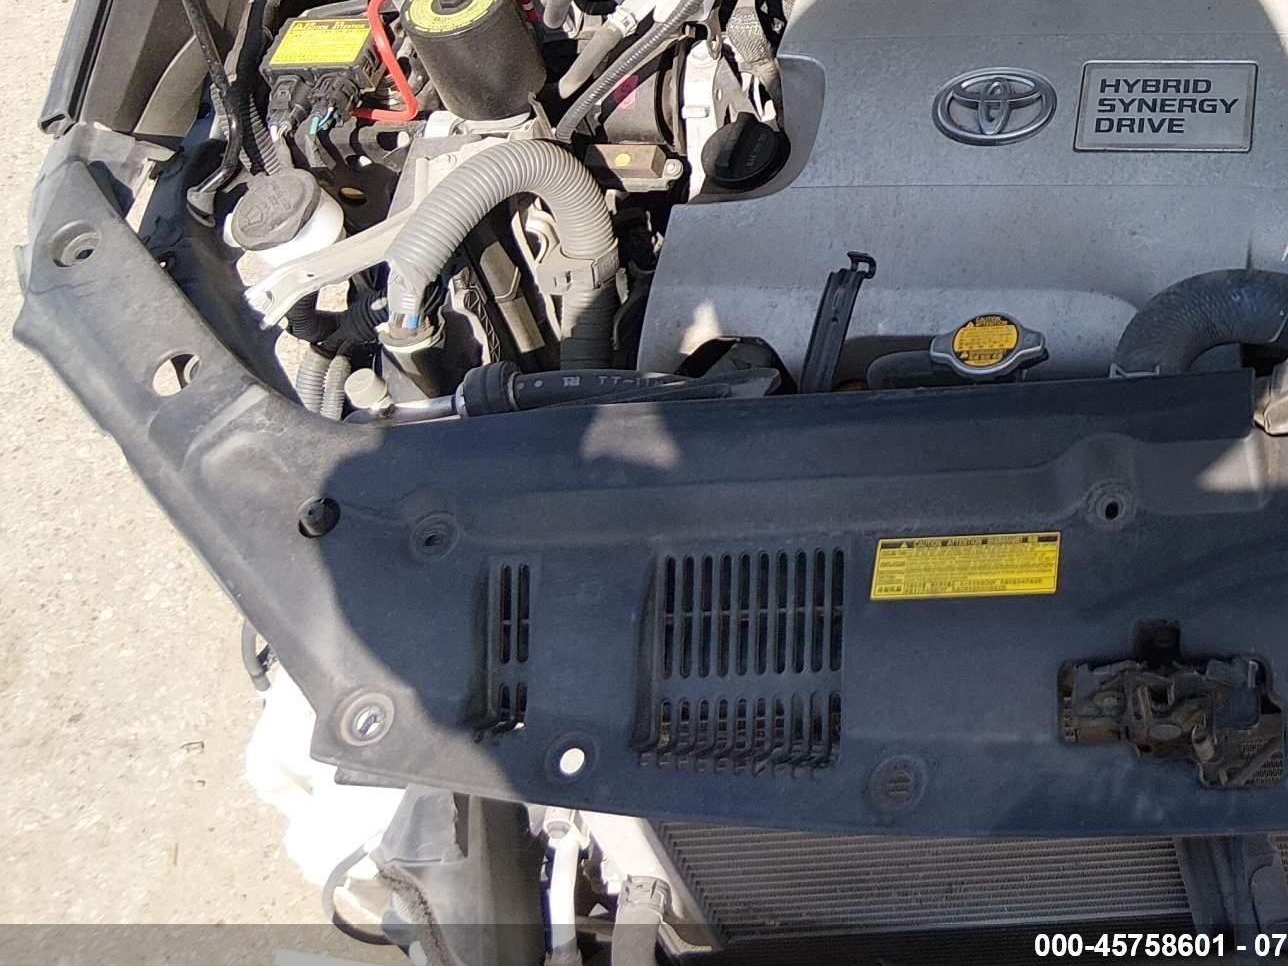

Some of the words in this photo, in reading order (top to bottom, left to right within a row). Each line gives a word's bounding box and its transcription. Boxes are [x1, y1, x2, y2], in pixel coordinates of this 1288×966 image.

[1099, 78, 1212, 94] HYBRID
[1097, 97, 1239, 114] SYNERGY
[1094, 117, 1185, 134] DRIVE
